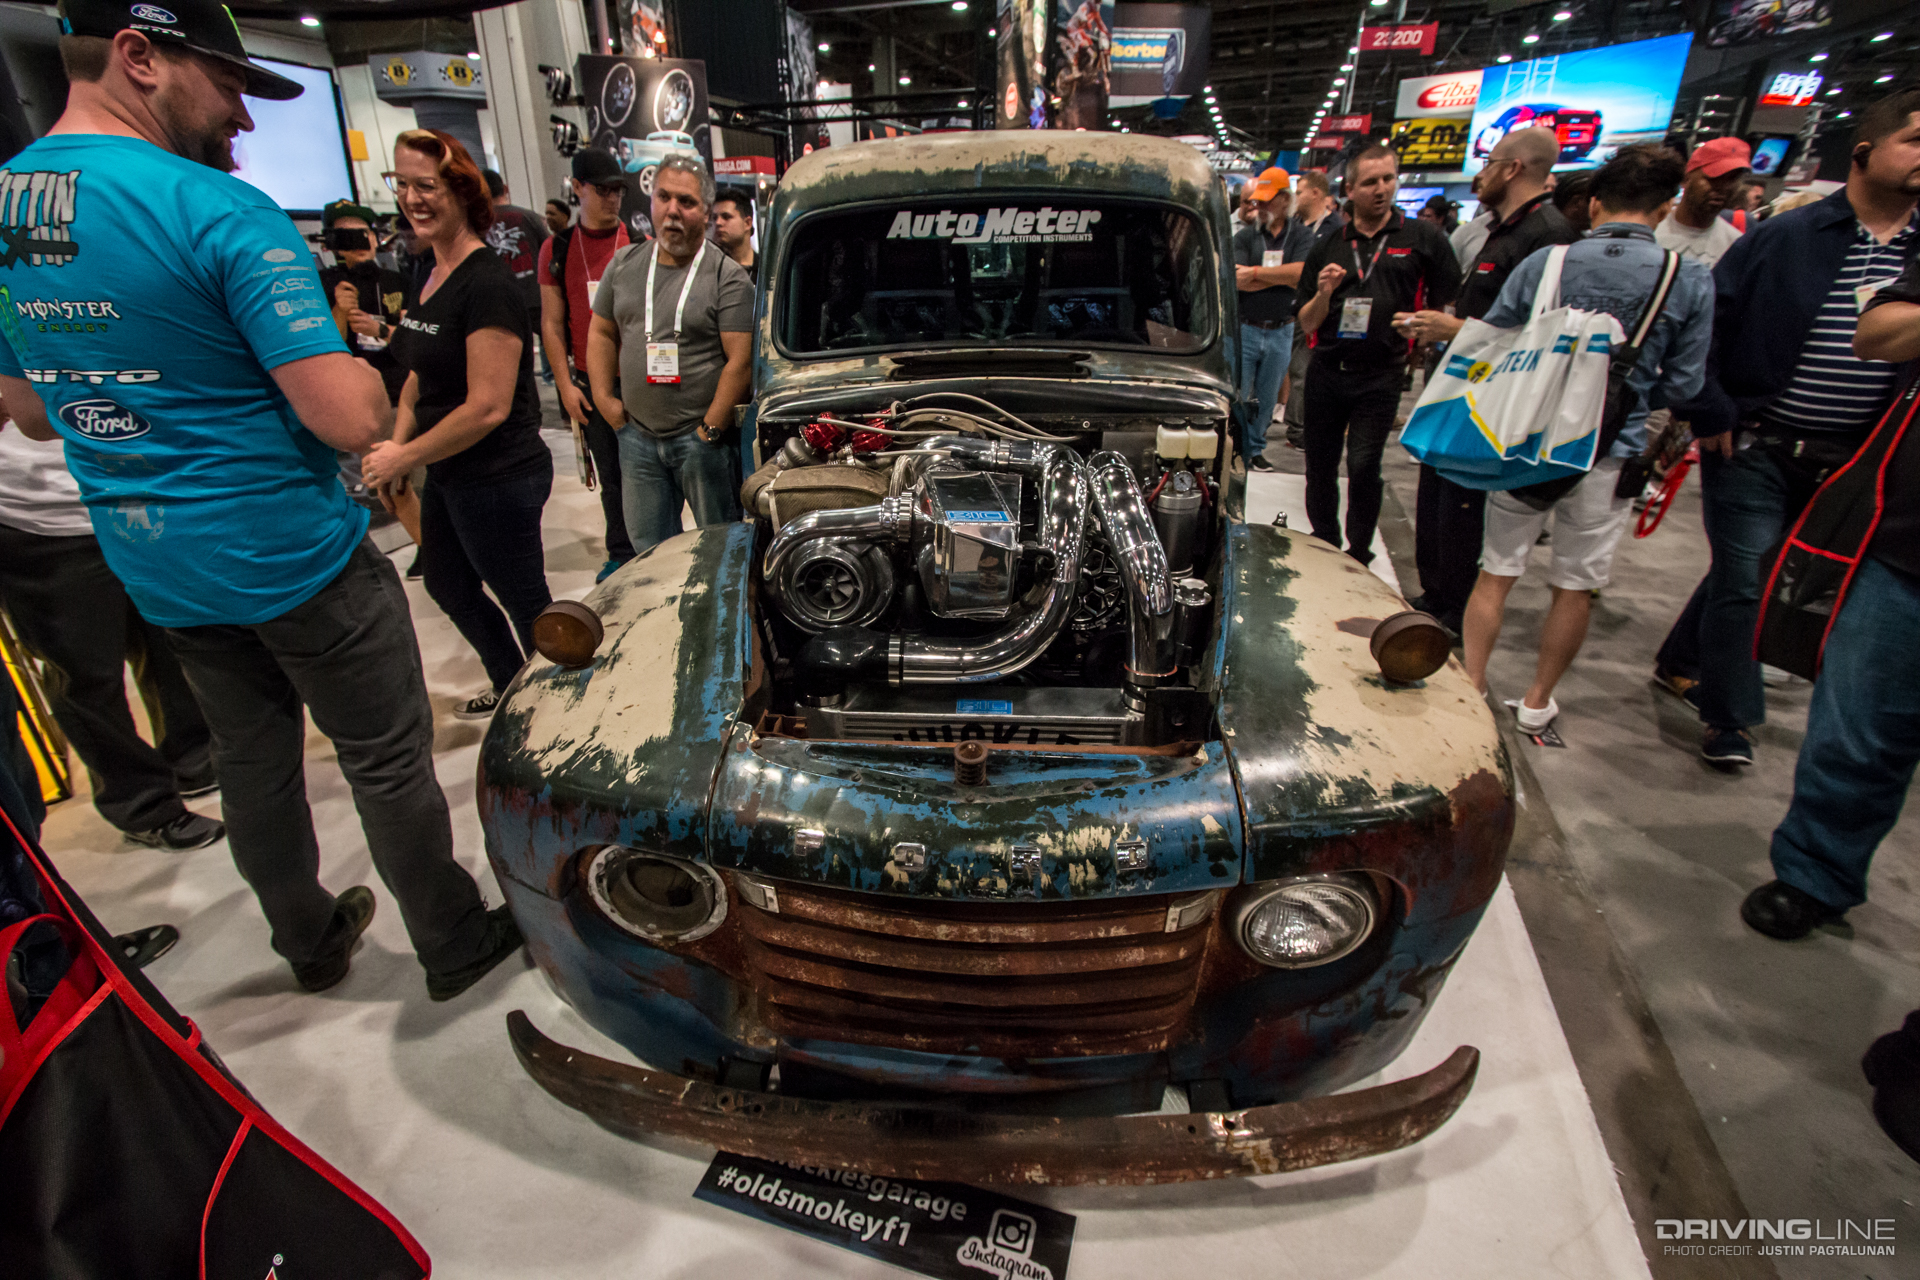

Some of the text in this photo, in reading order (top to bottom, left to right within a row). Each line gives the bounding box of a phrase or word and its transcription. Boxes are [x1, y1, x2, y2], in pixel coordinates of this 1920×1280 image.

[1372, 30, 1424, 46] 23200
[1417, 81, 1481, 109] Eiba
[0, 168, 82, 229] ITTIN
[994, 233, 1093, 244] COMPETITION INSTRUMENTS
[37, 323, 108, 333] ENERGY
[74, 405, 138, 434] Ford
[717, 1165, 911, 1247] #oldsmokeyf1
[962, 1241, 1047, 1280] Instagram
